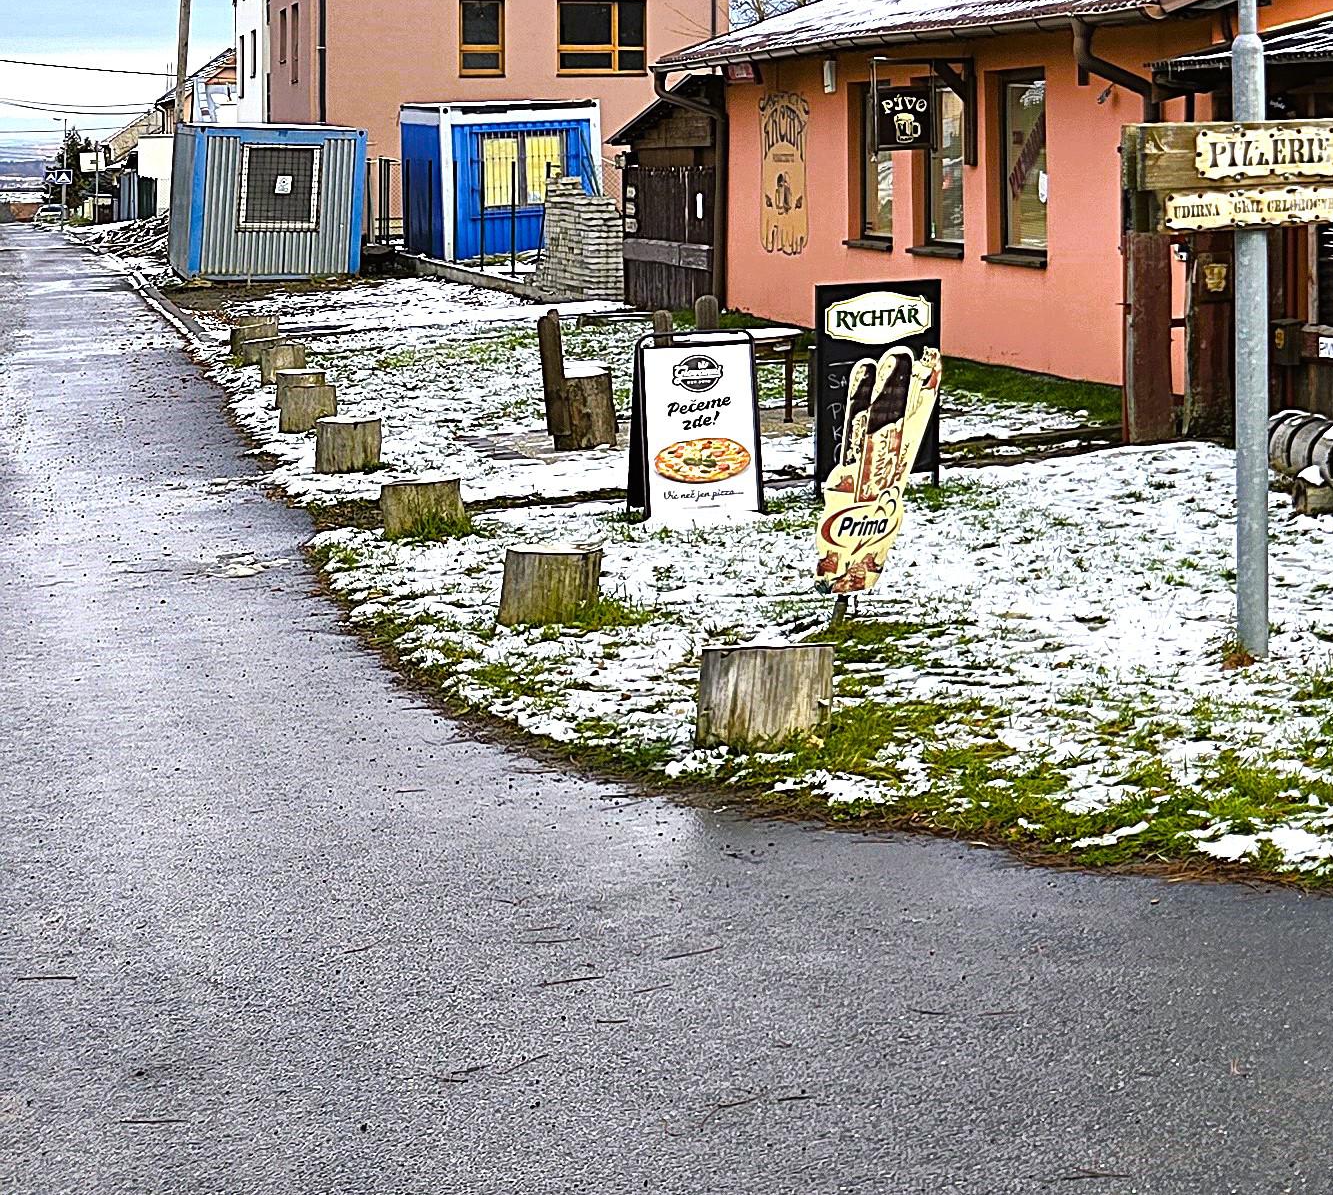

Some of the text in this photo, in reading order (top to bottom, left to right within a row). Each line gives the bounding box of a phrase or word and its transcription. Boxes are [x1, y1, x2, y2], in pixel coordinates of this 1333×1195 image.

[836, 304, 925, 331] RYCHTÁŘ
[667, 395, 731, 417] Pečeme
[682, 411, 720, 431] zde!
[837, 515, 888, 538] Prima
